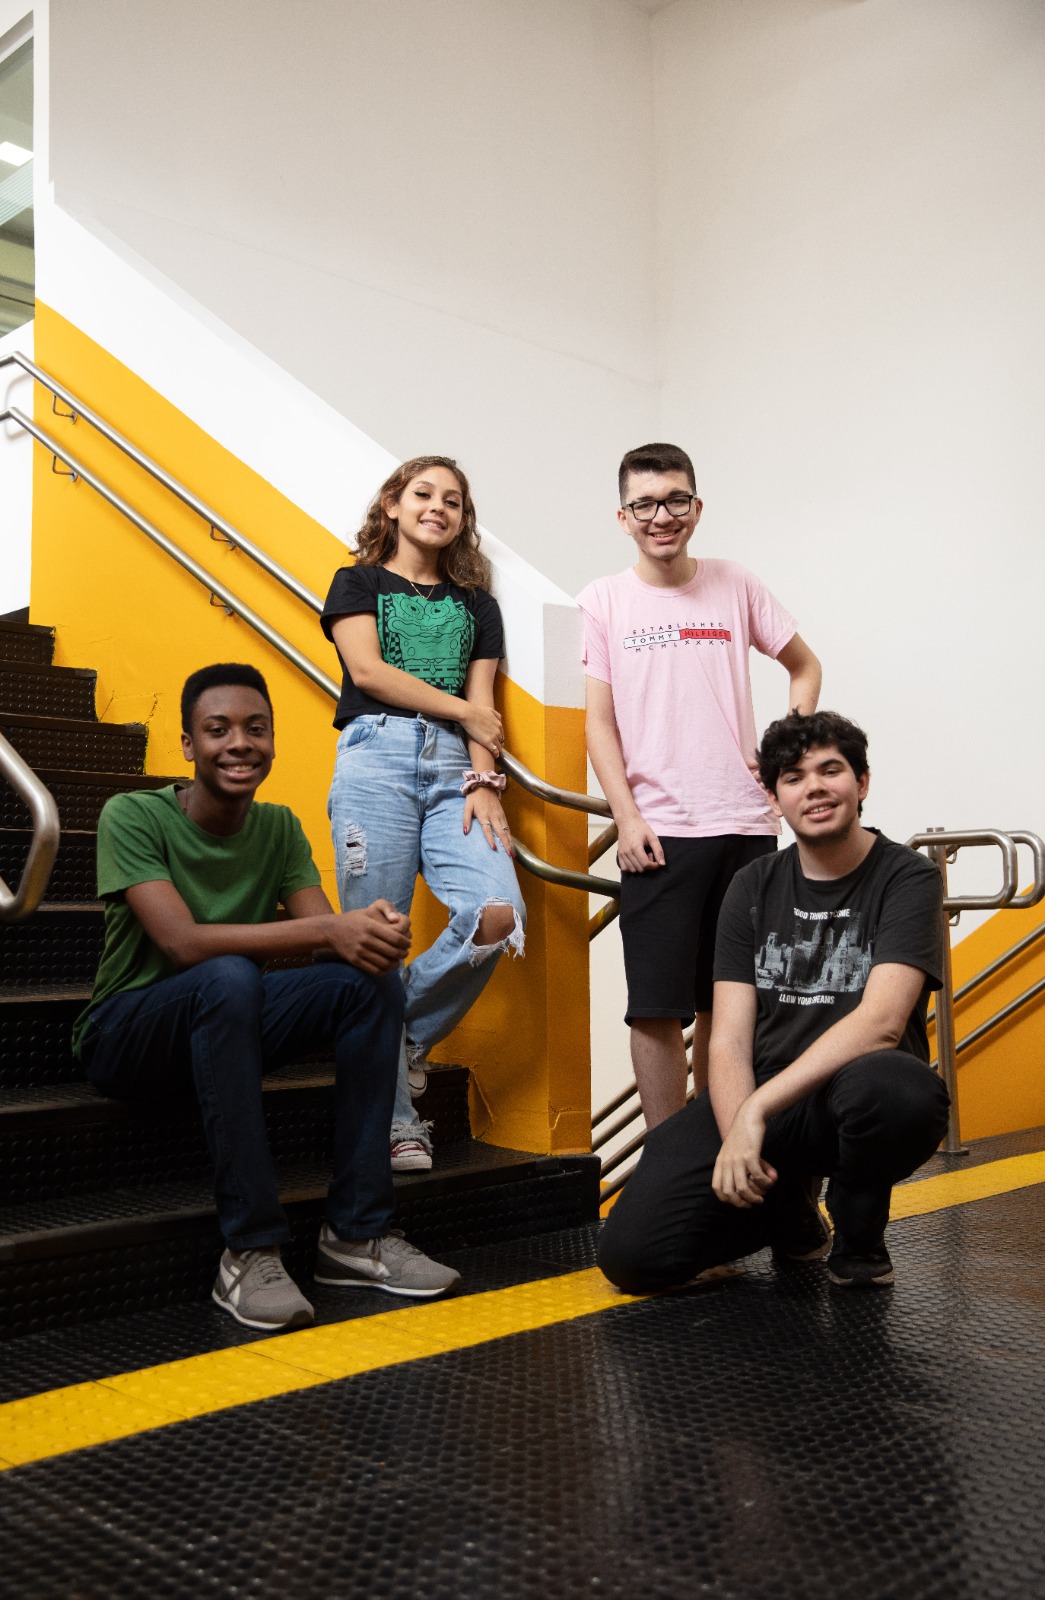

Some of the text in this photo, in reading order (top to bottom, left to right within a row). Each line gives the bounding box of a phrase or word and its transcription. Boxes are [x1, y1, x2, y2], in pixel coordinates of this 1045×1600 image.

[633, 622, 723, 634] ESTABLISHED
[632, 634, 673, 645] TOMMY
[636, 641, 724, 652] MCMLXXXV
[809, 911, 828, 920] THINGS
[779, 993, 796, 1004] LLOW
